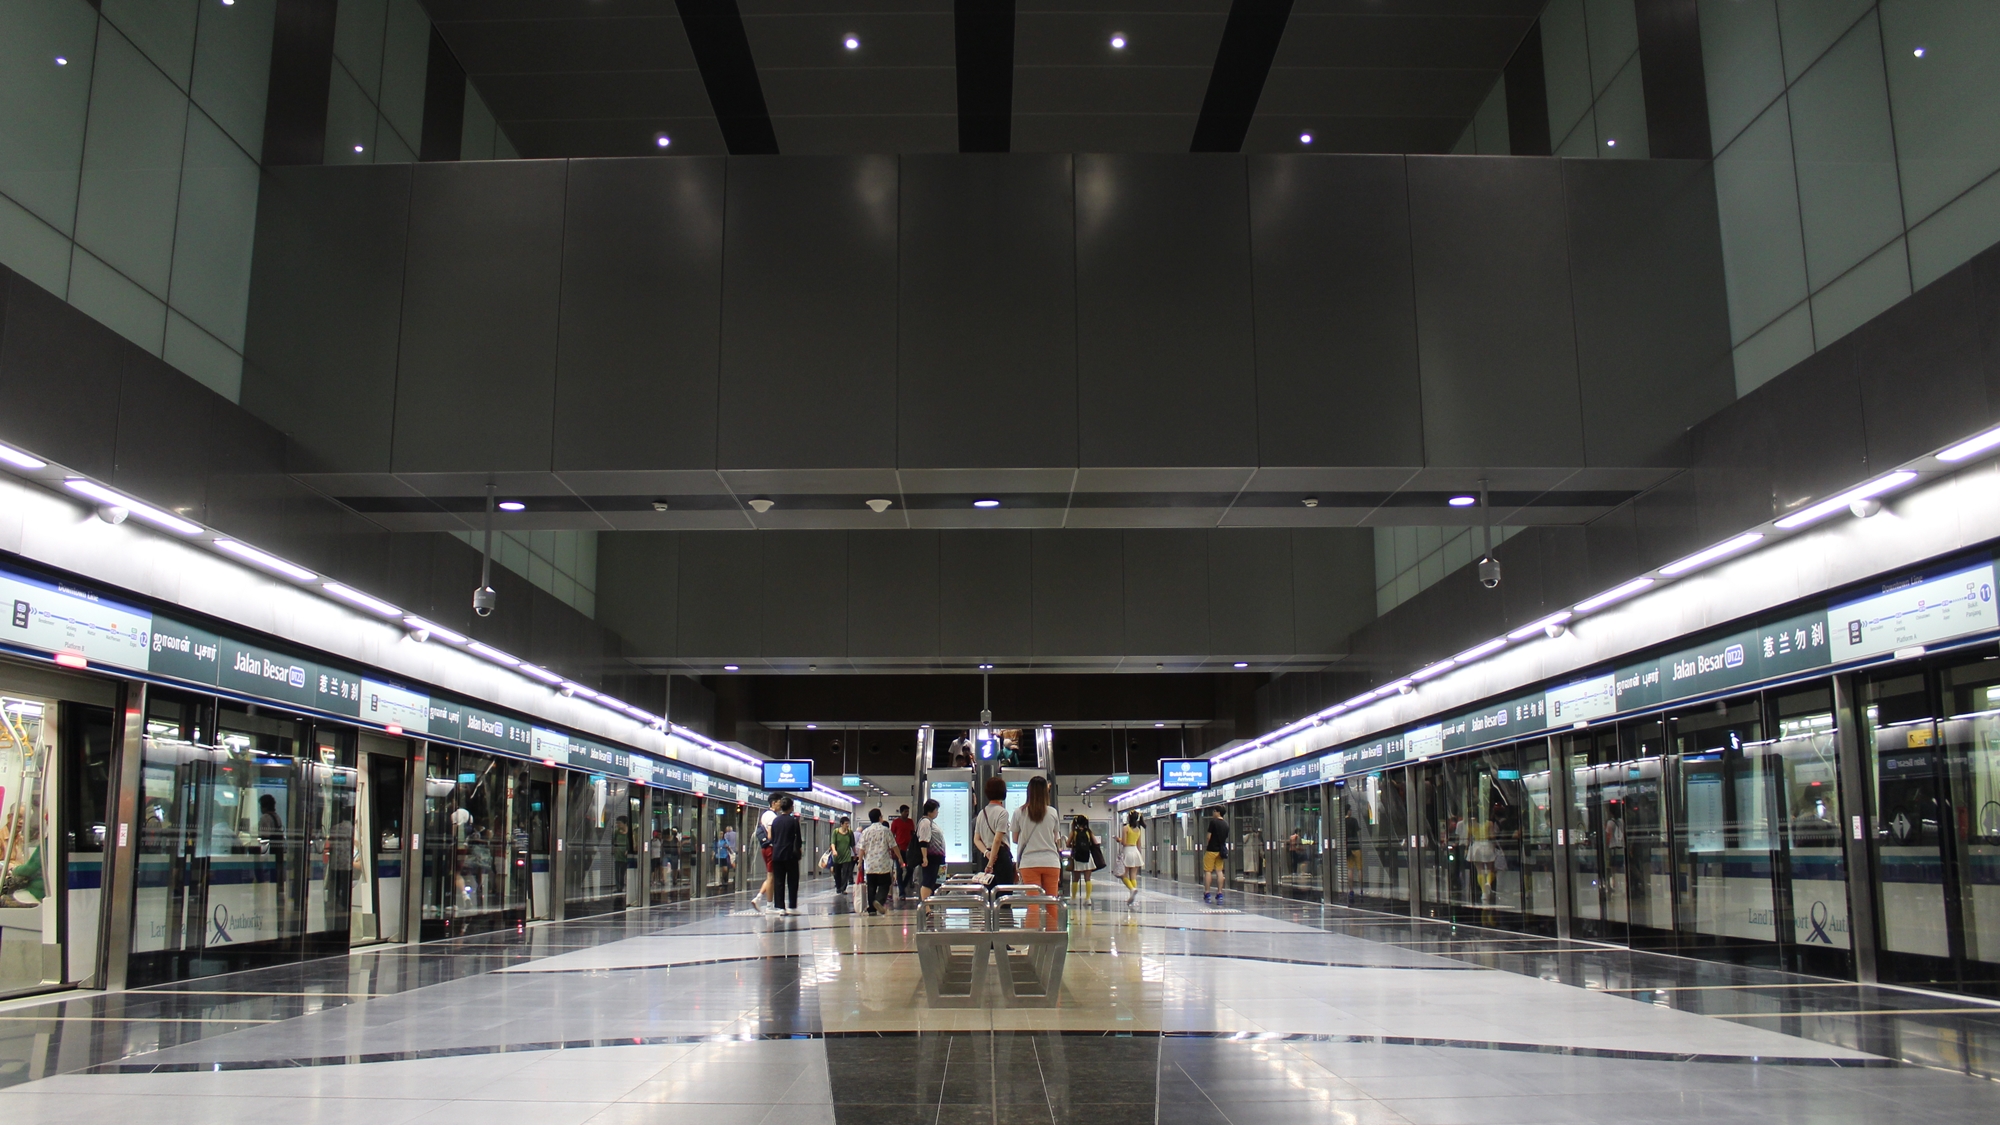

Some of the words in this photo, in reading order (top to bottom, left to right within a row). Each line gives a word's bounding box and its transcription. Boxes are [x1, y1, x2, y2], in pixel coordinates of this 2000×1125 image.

[1882, 580, 1910, 593] Downtown
[1910, 574, 1923, 583] Line
[1982, 587, 1990, 599] 11
[1763, 622, 1824, 658] 惹兰勿刹
[1896, 634, 1914, 643] Platform
[234, 652, 261, 676] Jalan
[263, 658, 289, 682] Besar
[290, 669, 304, 685] DT22
[1672, 662, 1696, 681] Jalan
[1698, 653, 1724, 674] Besar
[1726, 648, 1742, 665] DT22
[467, 715, 481, 730] Jalan
[482, 718, 495, 733] Besar
[1472, 716, 1484, 732] Jalan
[1484, 714, 1498, 728] Besar
[229, 912, 264, 930] Authority
[1748, 908, 1767, 925] Land
